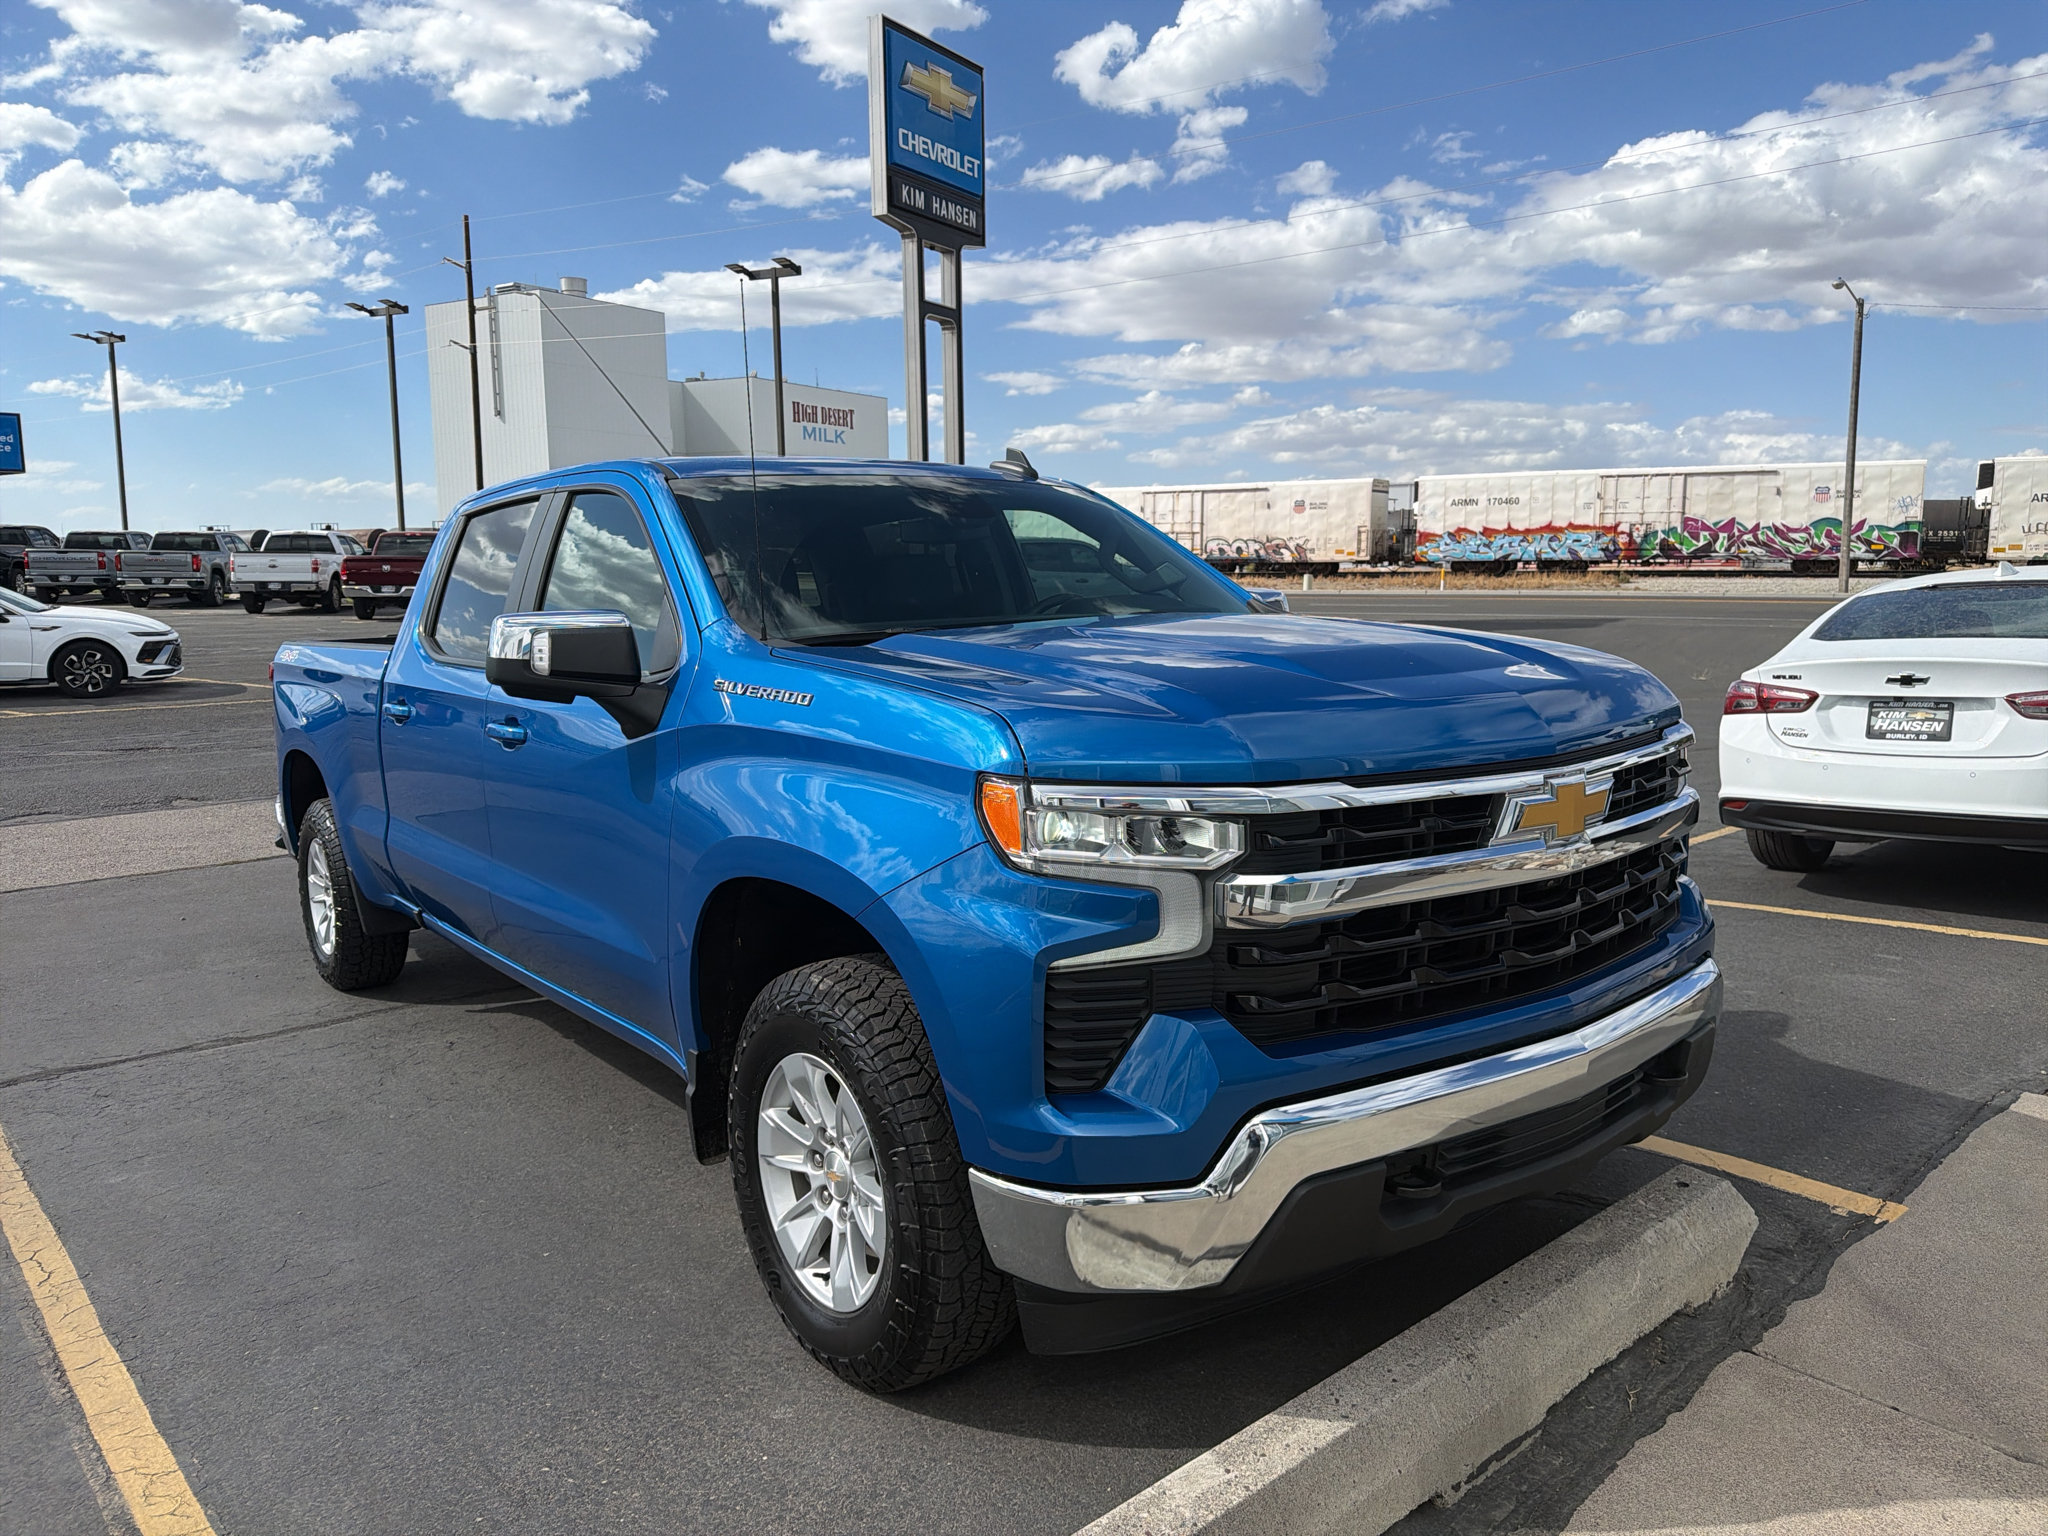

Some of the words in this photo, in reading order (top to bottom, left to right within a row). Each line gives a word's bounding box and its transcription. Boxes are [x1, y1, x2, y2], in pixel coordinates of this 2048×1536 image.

[898, 127, 980, 179] CHEVROLET
[901, 183, 925, 211] KIM
[932, 196, 977, 229] HANSEN
[792, 401, 819, 424] HIGH
[820, 406, 855, 430] DESERT
[802, 425, 846, 445] MILK
[1450, 498, 1479, 507] ARMN
[1487, 497, 1520, 506] 170460
[713, 679, 814, 707] SILVERADO
[1873, 718, 1945, 732] HANSEN
[1877, 711, 1907, 719] KIM
[1781, 730, 1808, 738] HANSEN
